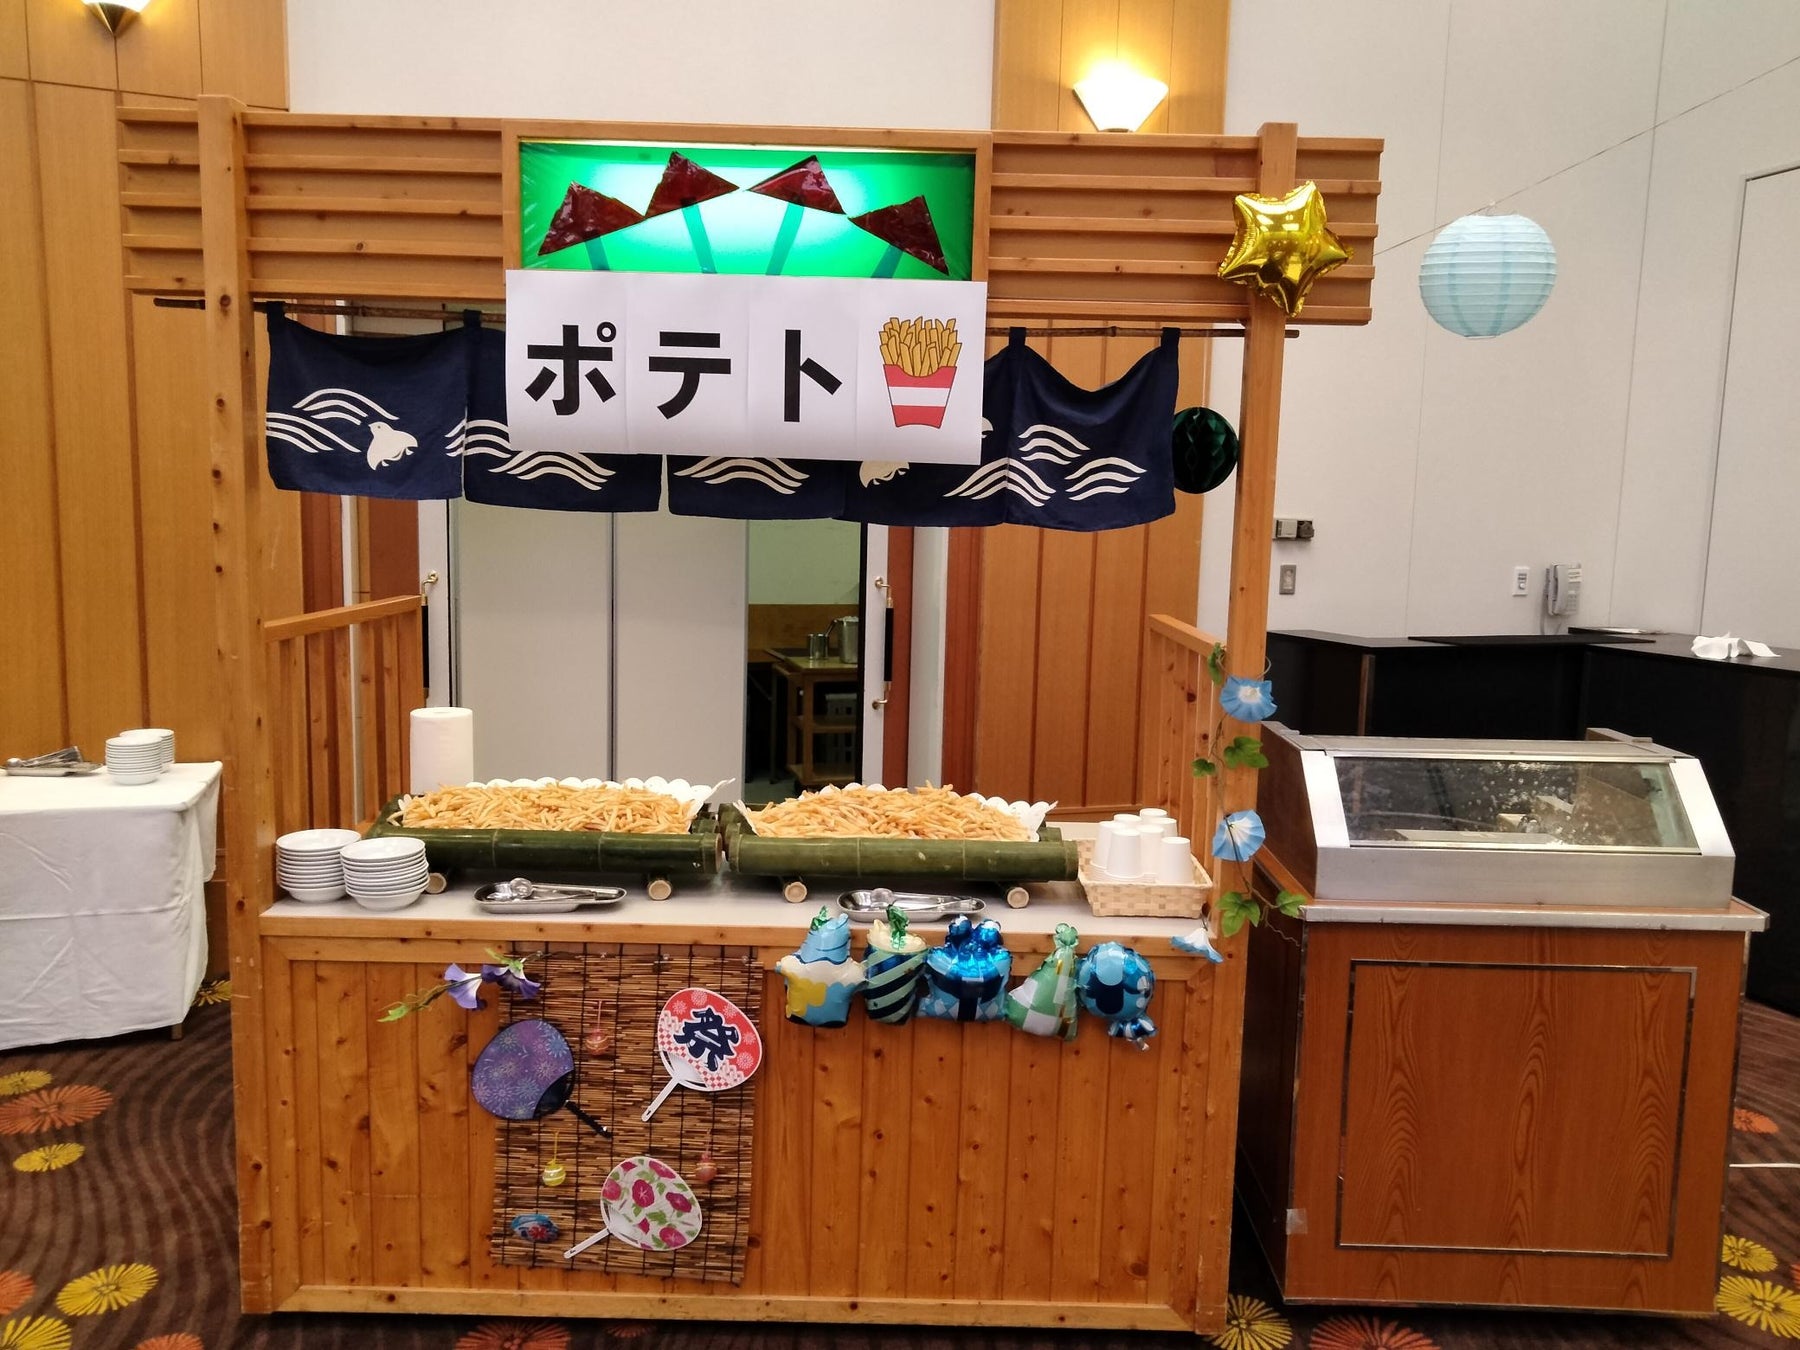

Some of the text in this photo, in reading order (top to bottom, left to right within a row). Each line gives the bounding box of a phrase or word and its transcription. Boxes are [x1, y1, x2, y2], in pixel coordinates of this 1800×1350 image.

[525, 322, 842, 423] ポテト
[673, 1007, 740, 1072] 祭
